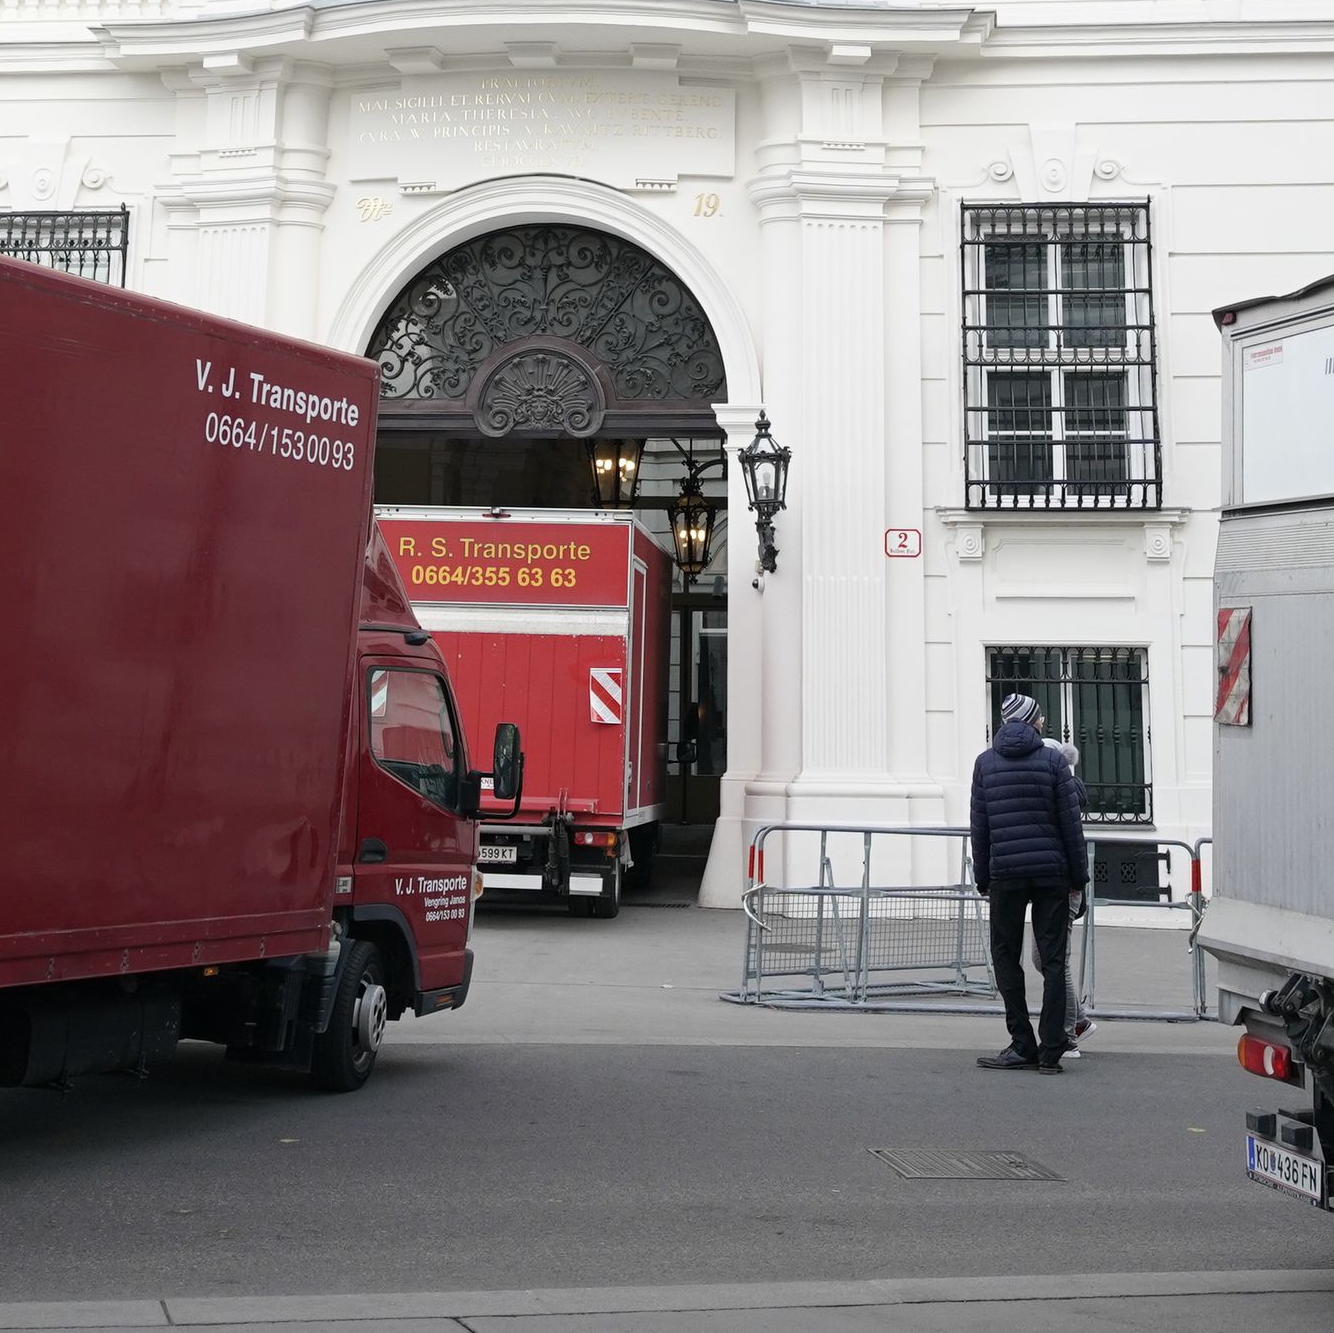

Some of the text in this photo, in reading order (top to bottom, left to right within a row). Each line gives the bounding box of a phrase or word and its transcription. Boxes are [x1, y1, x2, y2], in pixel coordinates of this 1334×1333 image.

[195, 358, 360, 427] V. J. Transporte
[398, 536, 591, 564] R. S. Transporte
[898, 532, 908, 549] 2
[411, 564, 577, 588] 0664/355 63 63
[395, 874, 467, 896] V. J. Transporte
